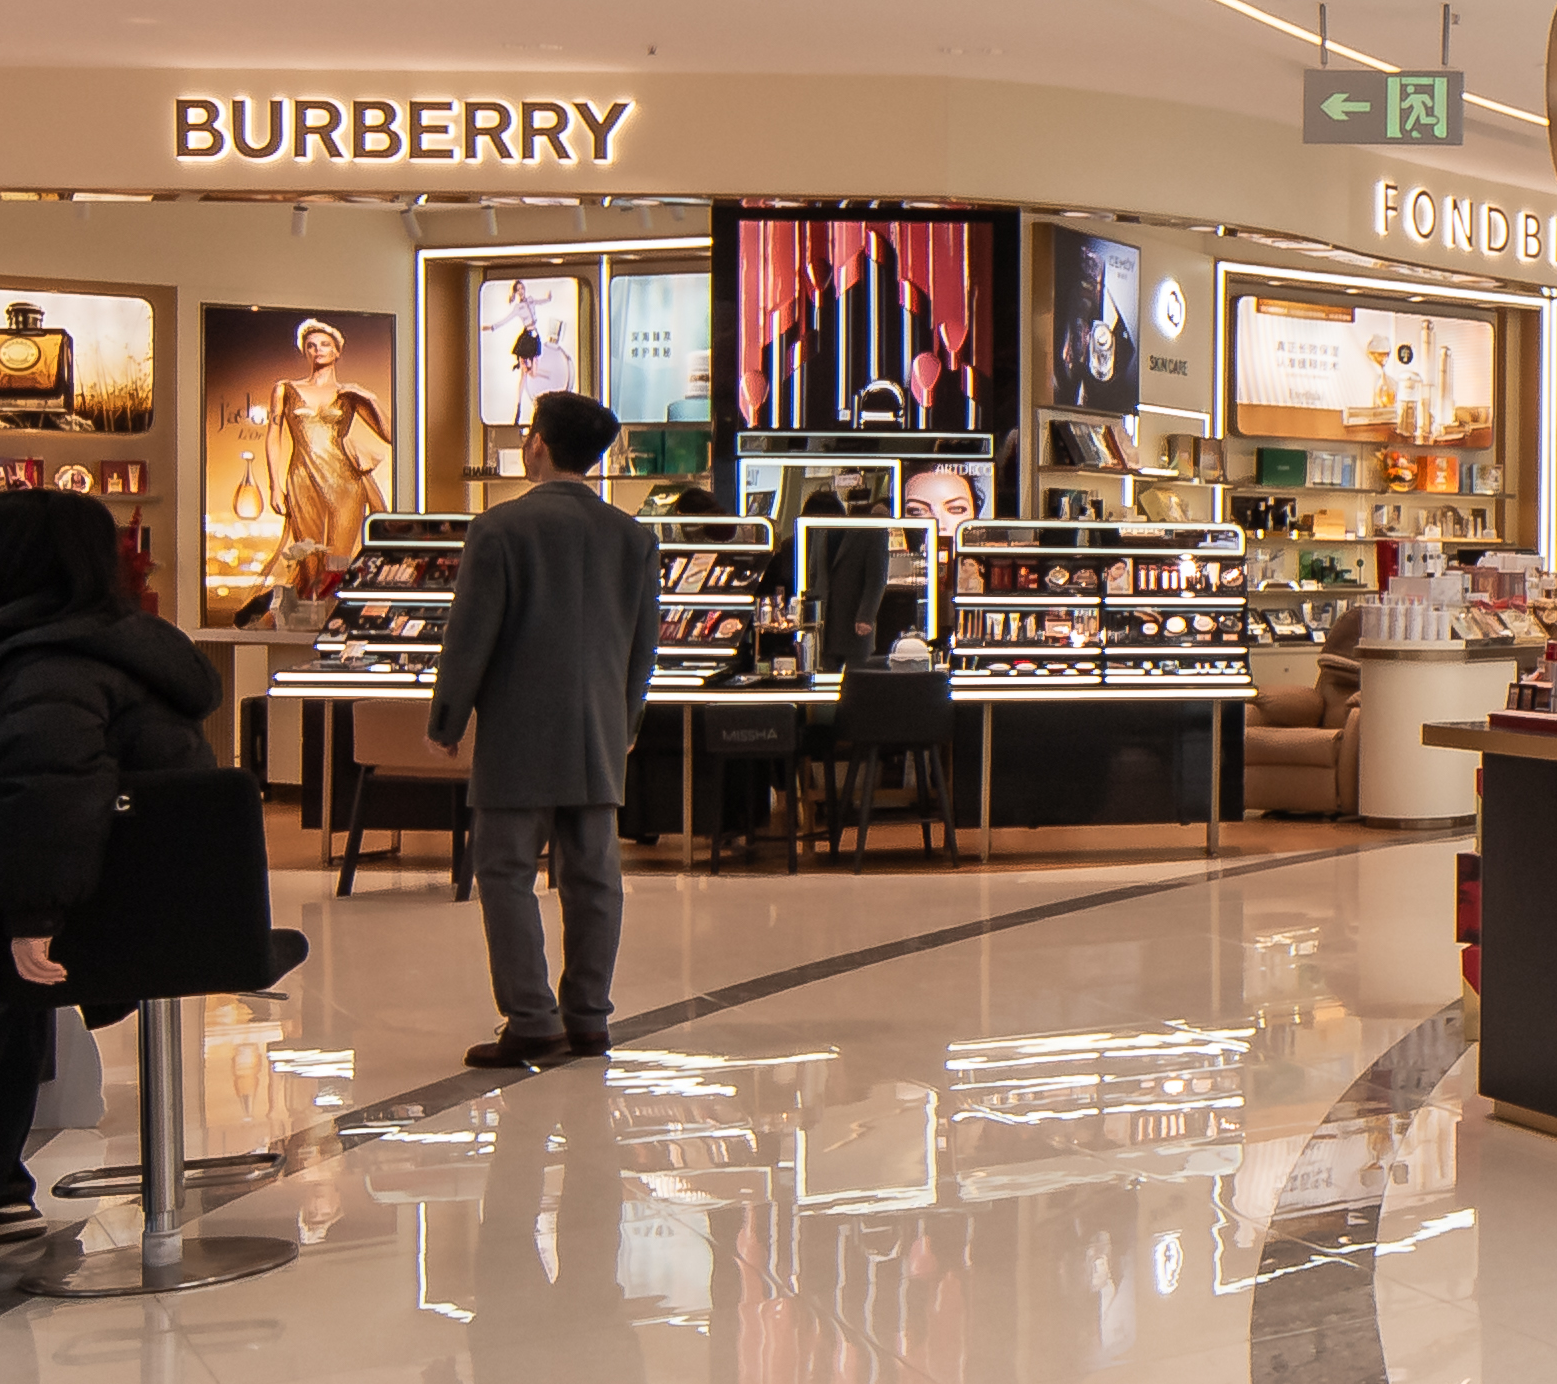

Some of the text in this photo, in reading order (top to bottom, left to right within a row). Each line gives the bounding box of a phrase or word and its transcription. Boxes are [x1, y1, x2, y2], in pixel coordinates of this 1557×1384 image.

[176, 97, 635, 164] BURBERRY
[934, 462, 994, 476] ARTDECO
[722, 728, 778, 742] MISSHA
